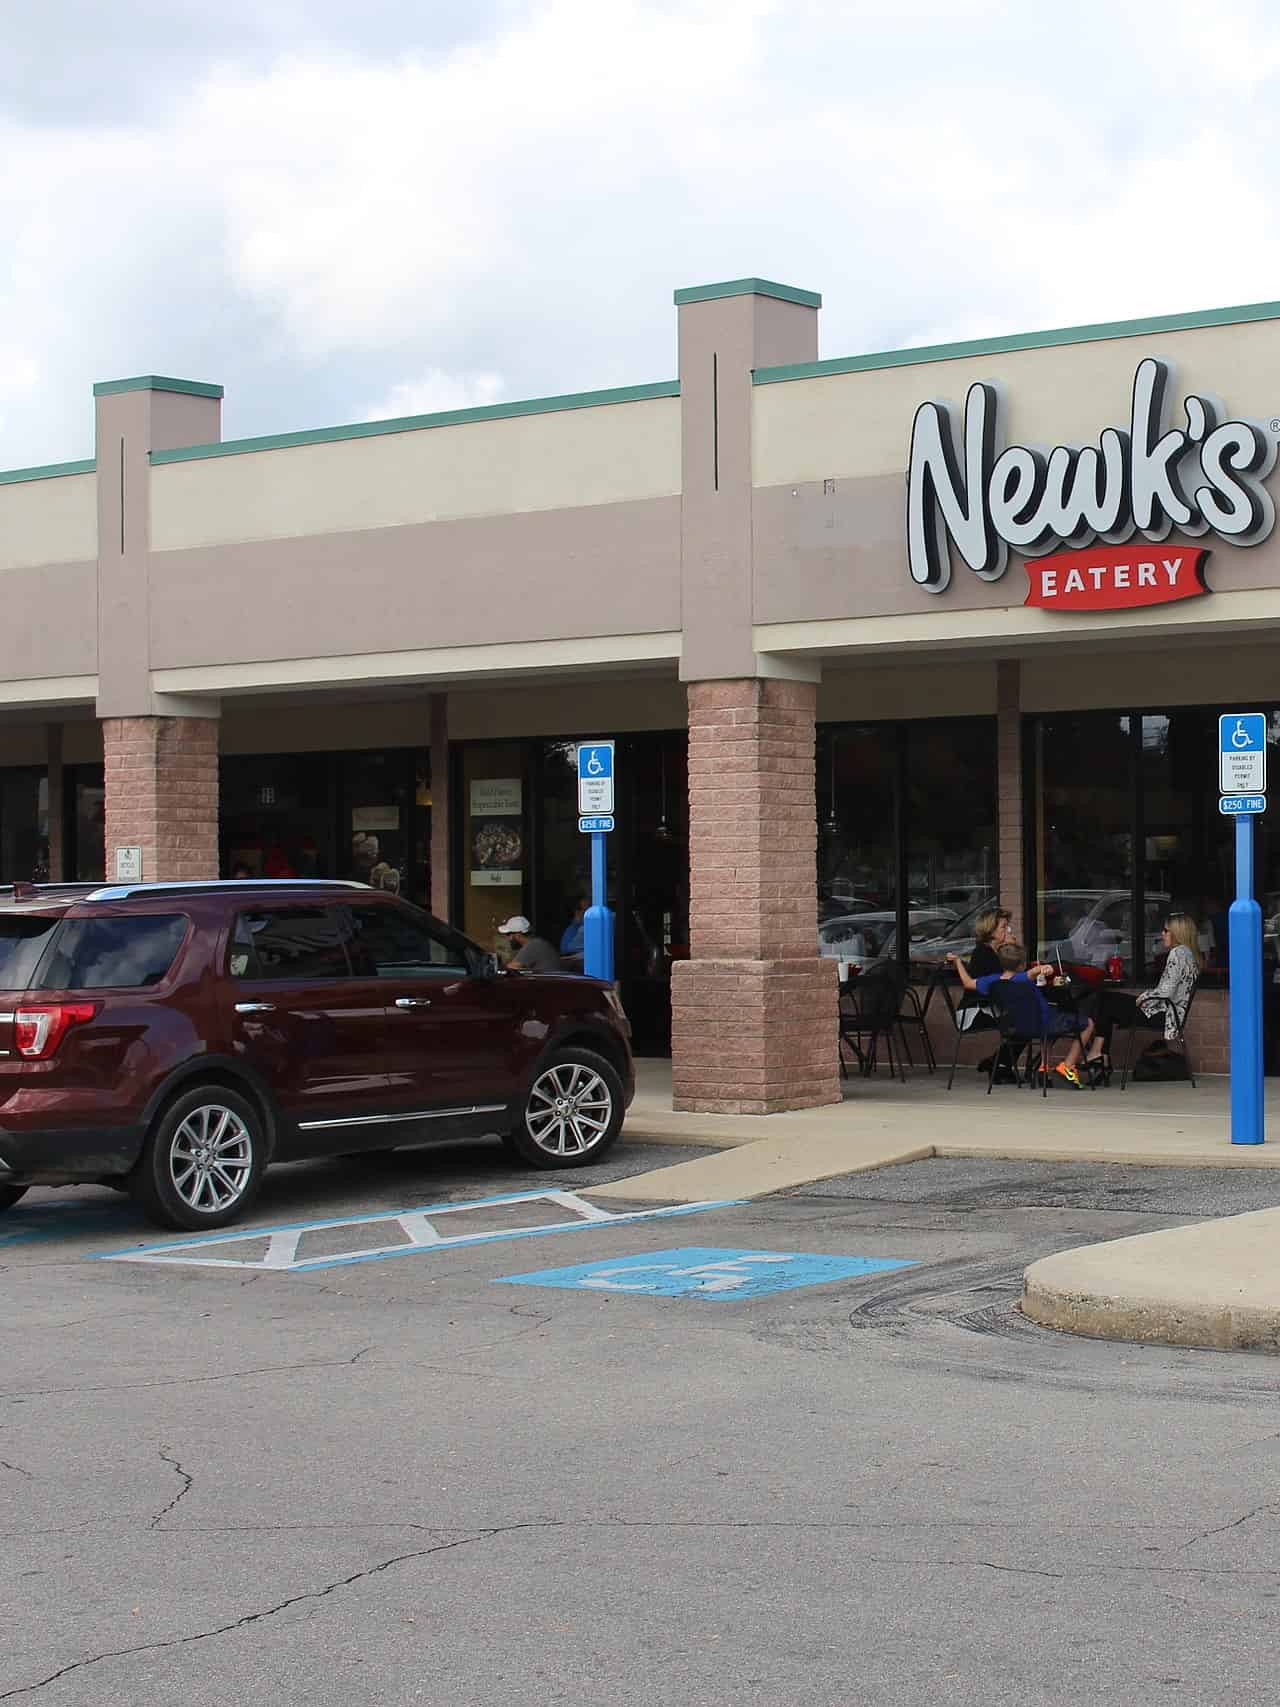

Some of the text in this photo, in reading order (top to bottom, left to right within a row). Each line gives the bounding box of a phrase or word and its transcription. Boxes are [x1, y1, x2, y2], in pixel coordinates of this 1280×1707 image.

[907, 358, 1268, 585] Newk's
[1040, 558, 1184, 598] EATERY
[1223, 800, 1263, 810] $250 FINE
